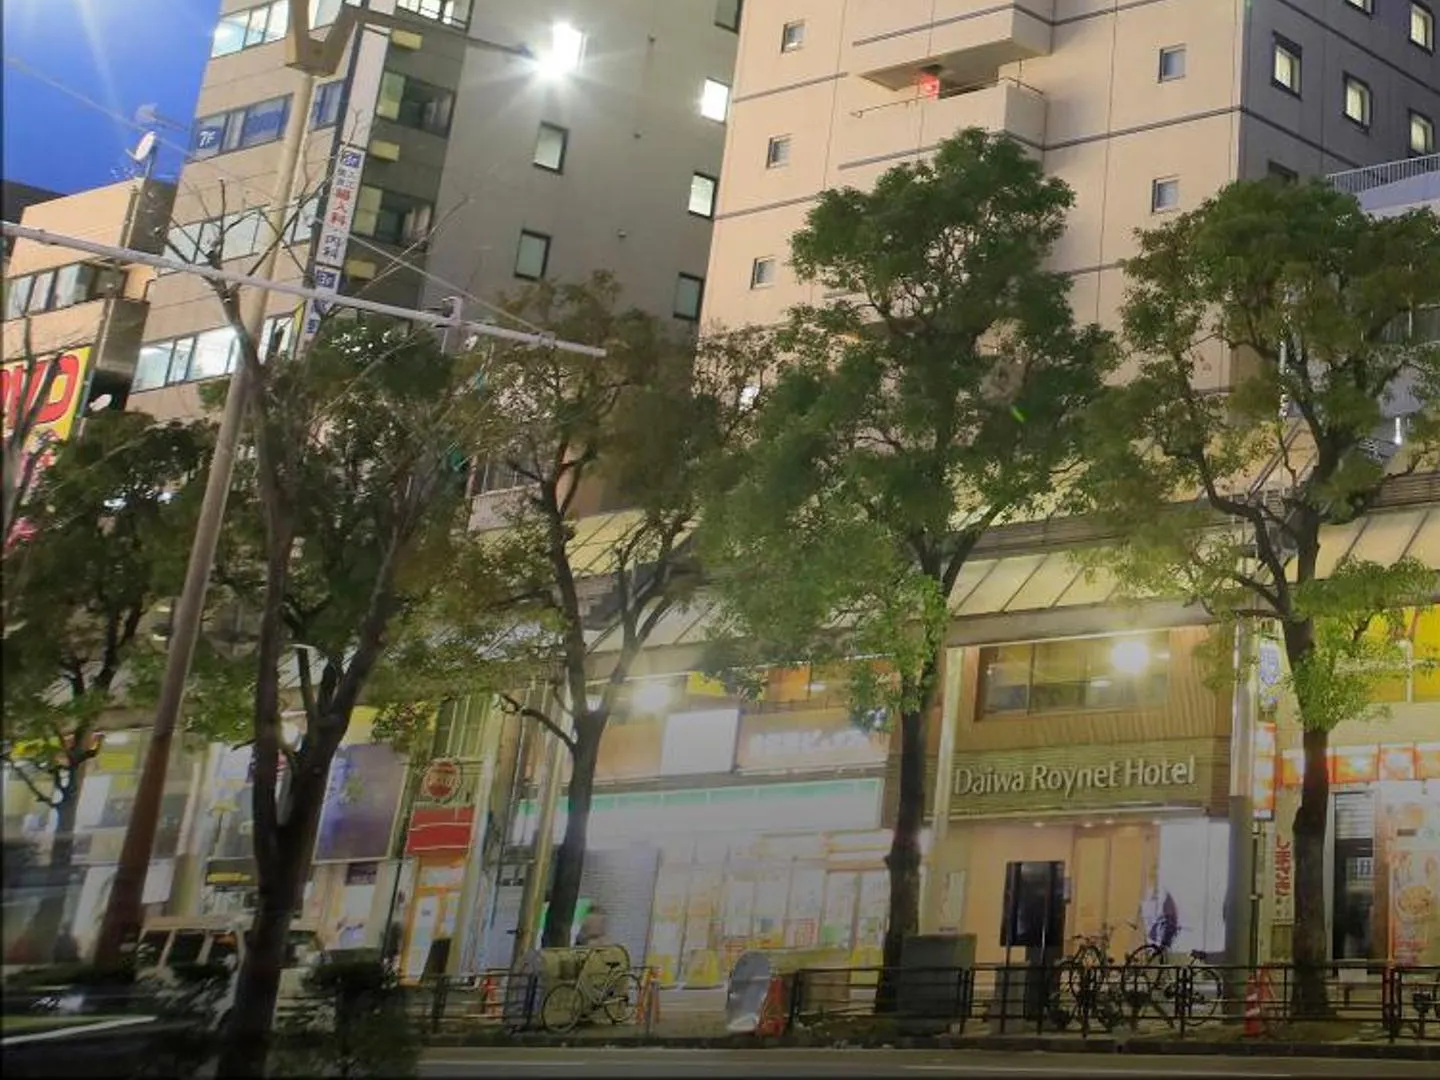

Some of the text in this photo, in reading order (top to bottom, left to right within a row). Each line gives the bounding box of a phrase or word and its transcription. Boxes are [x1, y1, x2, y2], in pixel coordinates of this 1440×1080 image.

[953, 754, 1196, 798] Daiwa Roynet Hotel
